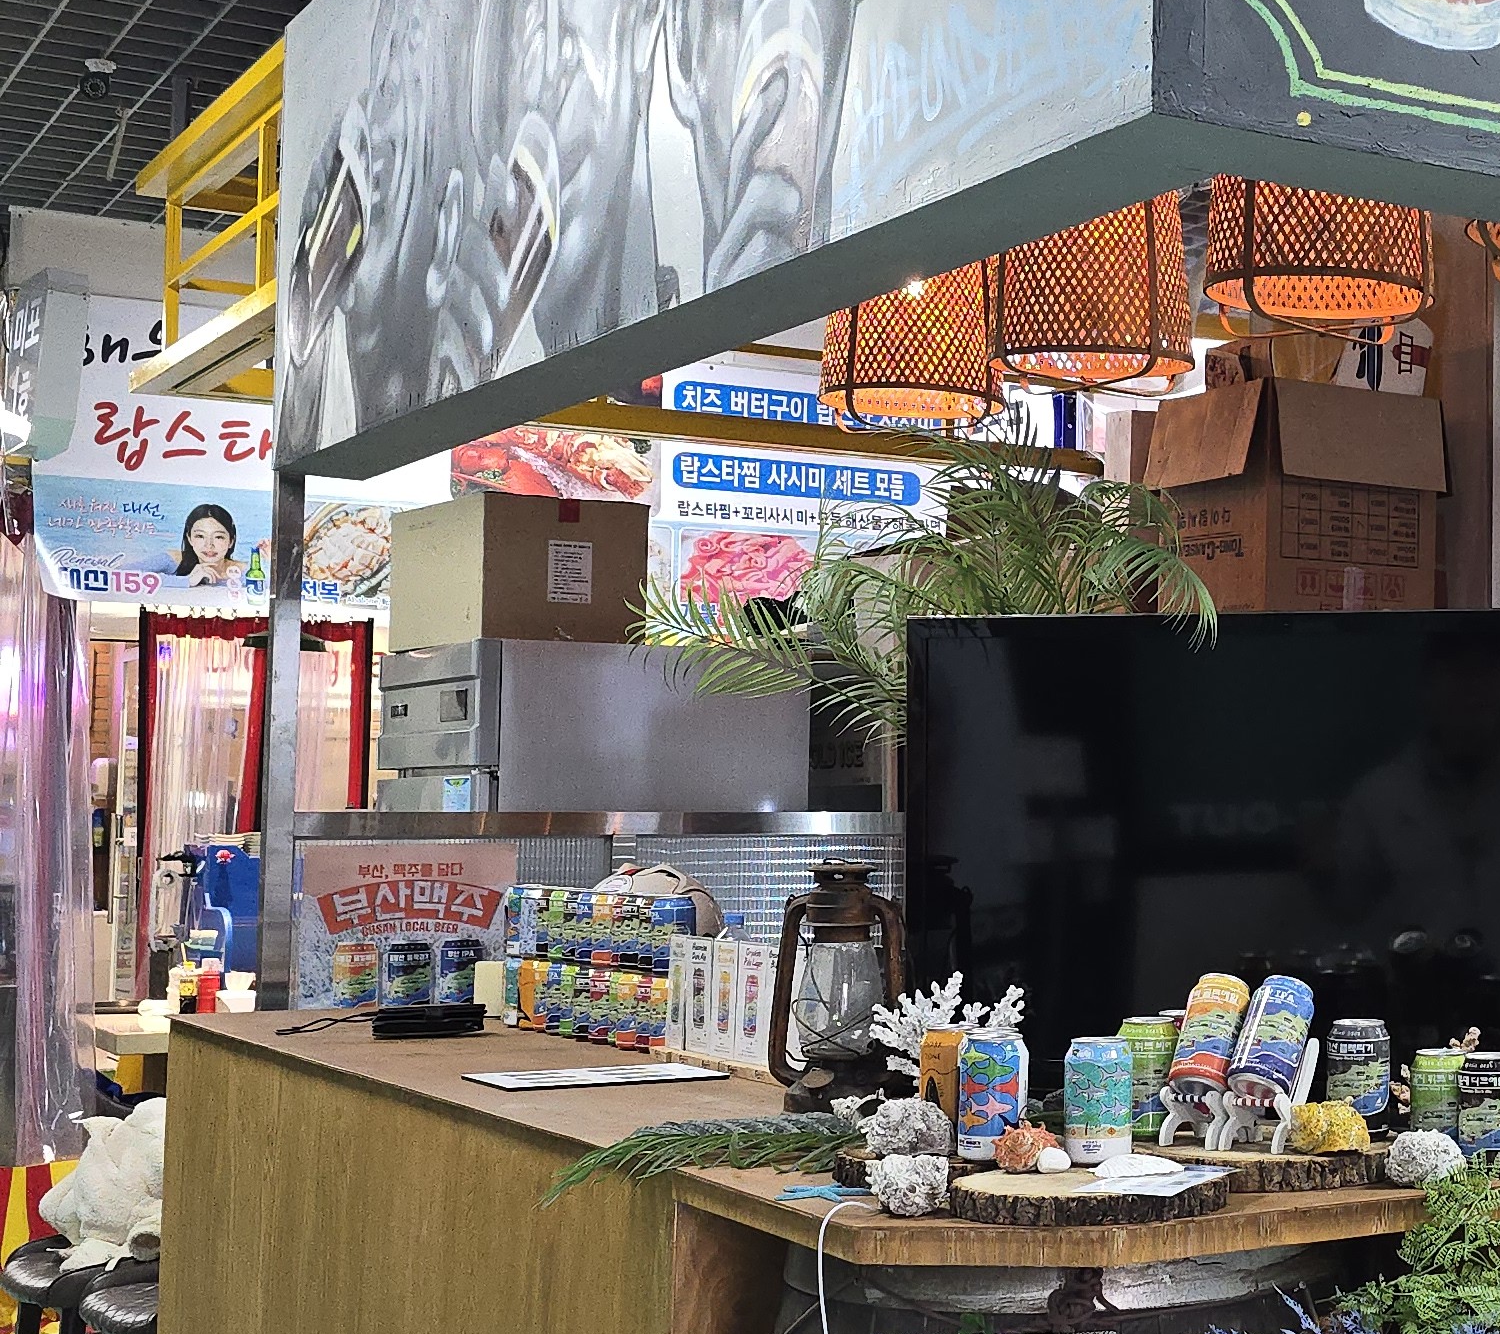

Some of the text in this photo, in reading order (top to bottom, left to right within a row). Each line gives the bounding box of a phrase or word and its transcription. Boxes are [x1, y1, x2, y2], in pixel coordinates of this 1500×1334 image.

[682, 385, 722, 413] 치즈
[730, 391, 808, 424] 버터구이
[93, 401, 274, 471] 랍스타
[680, 455, 760, 488] 랍스타찜
[767, 464, 826, 493] 사시미
[332, 879, 490, 925] 부산맥주
[399, 921, 429, 933] LOCAL
[434, 921, 459, 934] BEER
